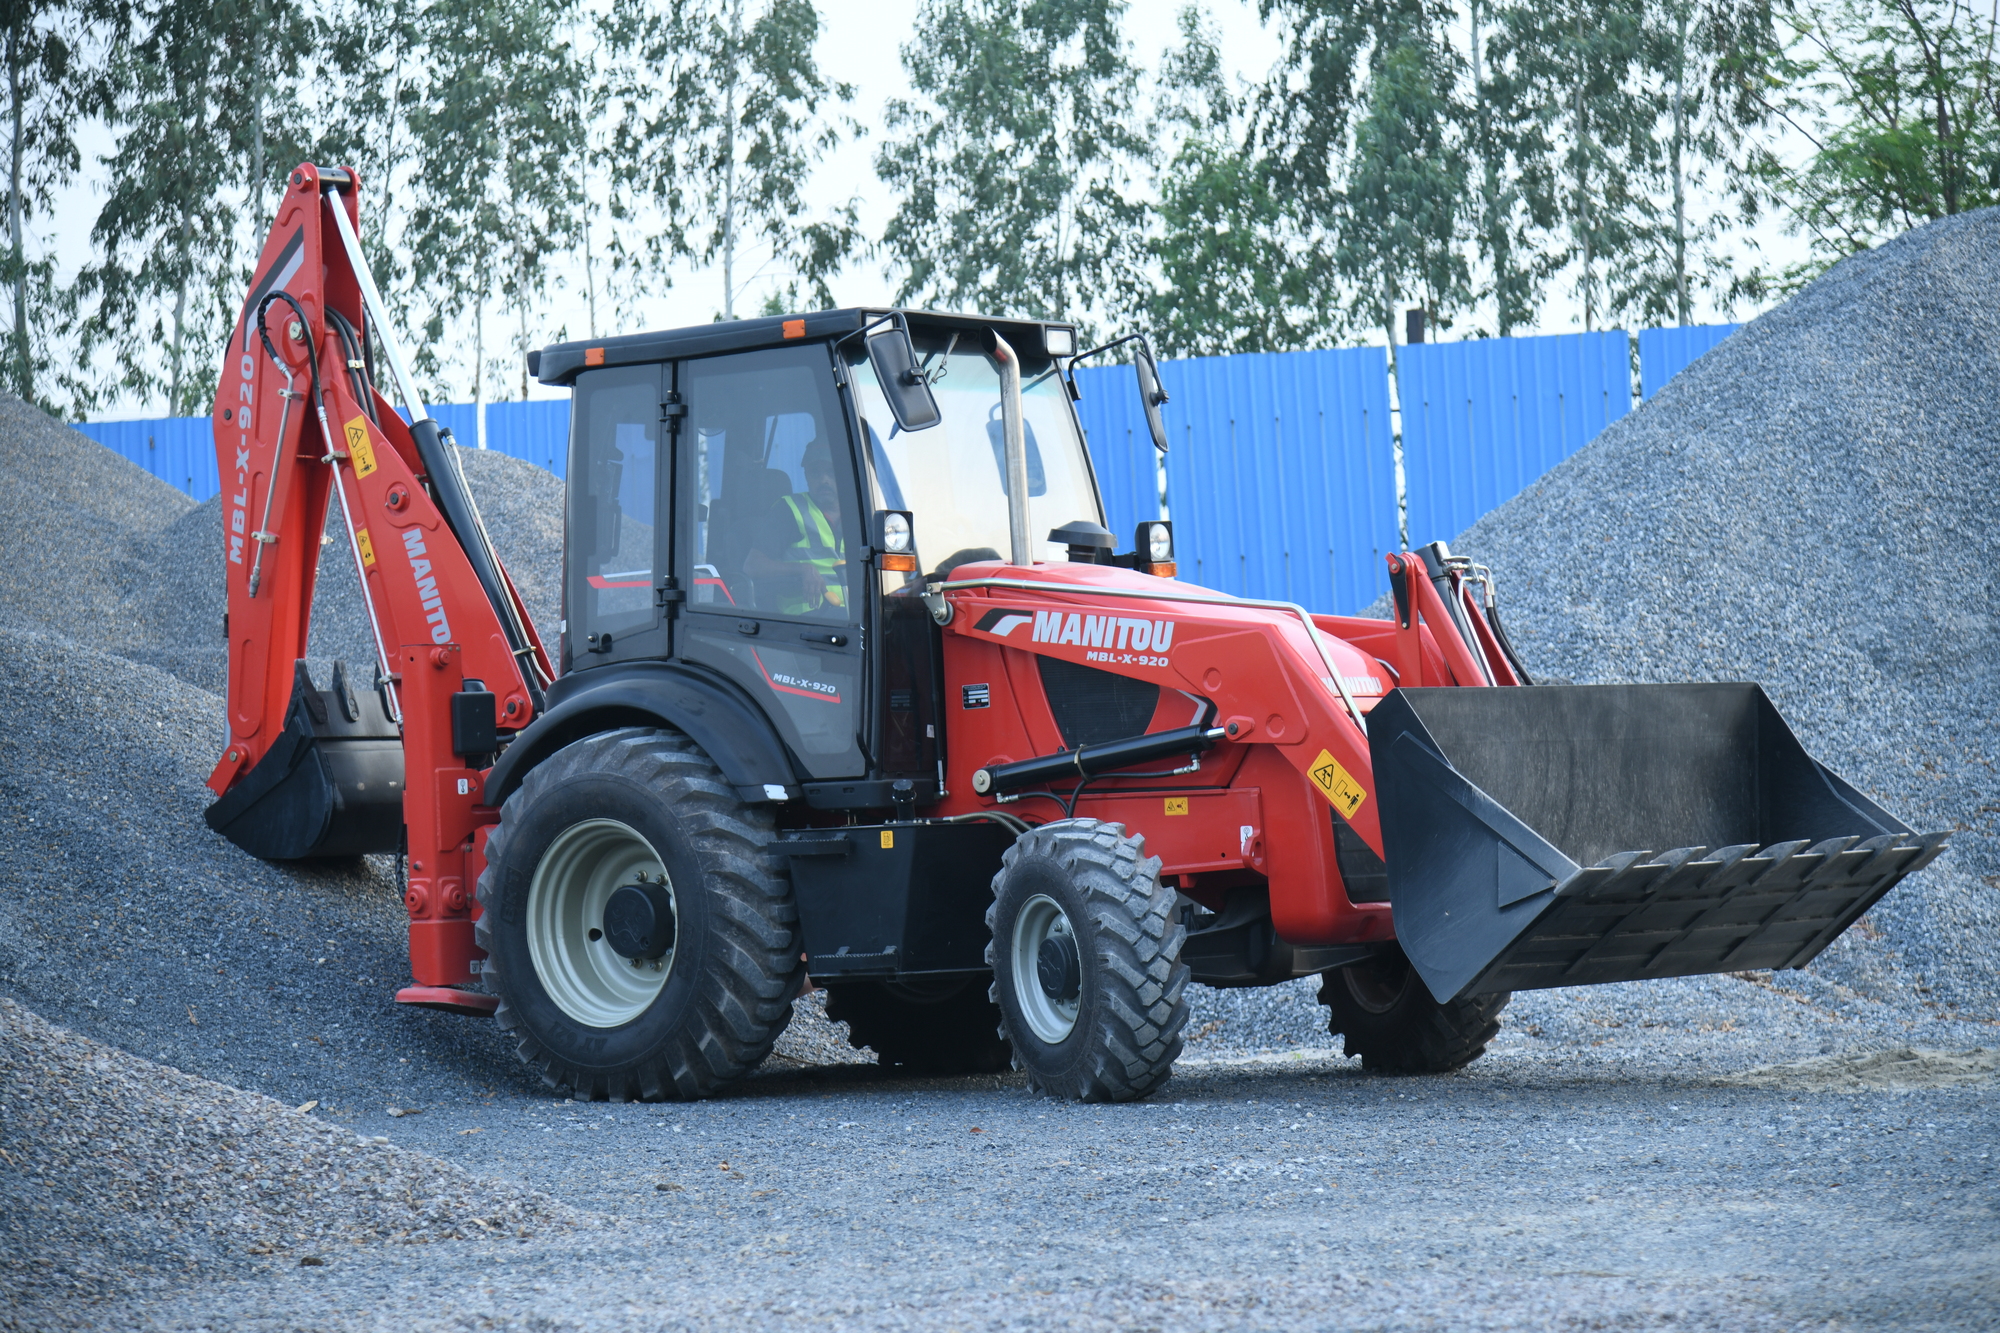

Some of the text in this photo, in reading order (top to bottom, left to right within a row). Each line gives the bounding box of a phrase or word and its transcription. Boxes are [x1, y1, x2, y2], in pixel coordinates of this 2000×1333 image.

[229, 354, 255, 565] MBL-X-920
[401, 527, 454, 645] MANITO
[1031, 610, 1175, 653] MANITOU
[1086, 650, 1169, 668] MBL-X-920
[772, 671, 837, 694] MBL-X-920
[1321, 676, 1383, 693] MNITOU
